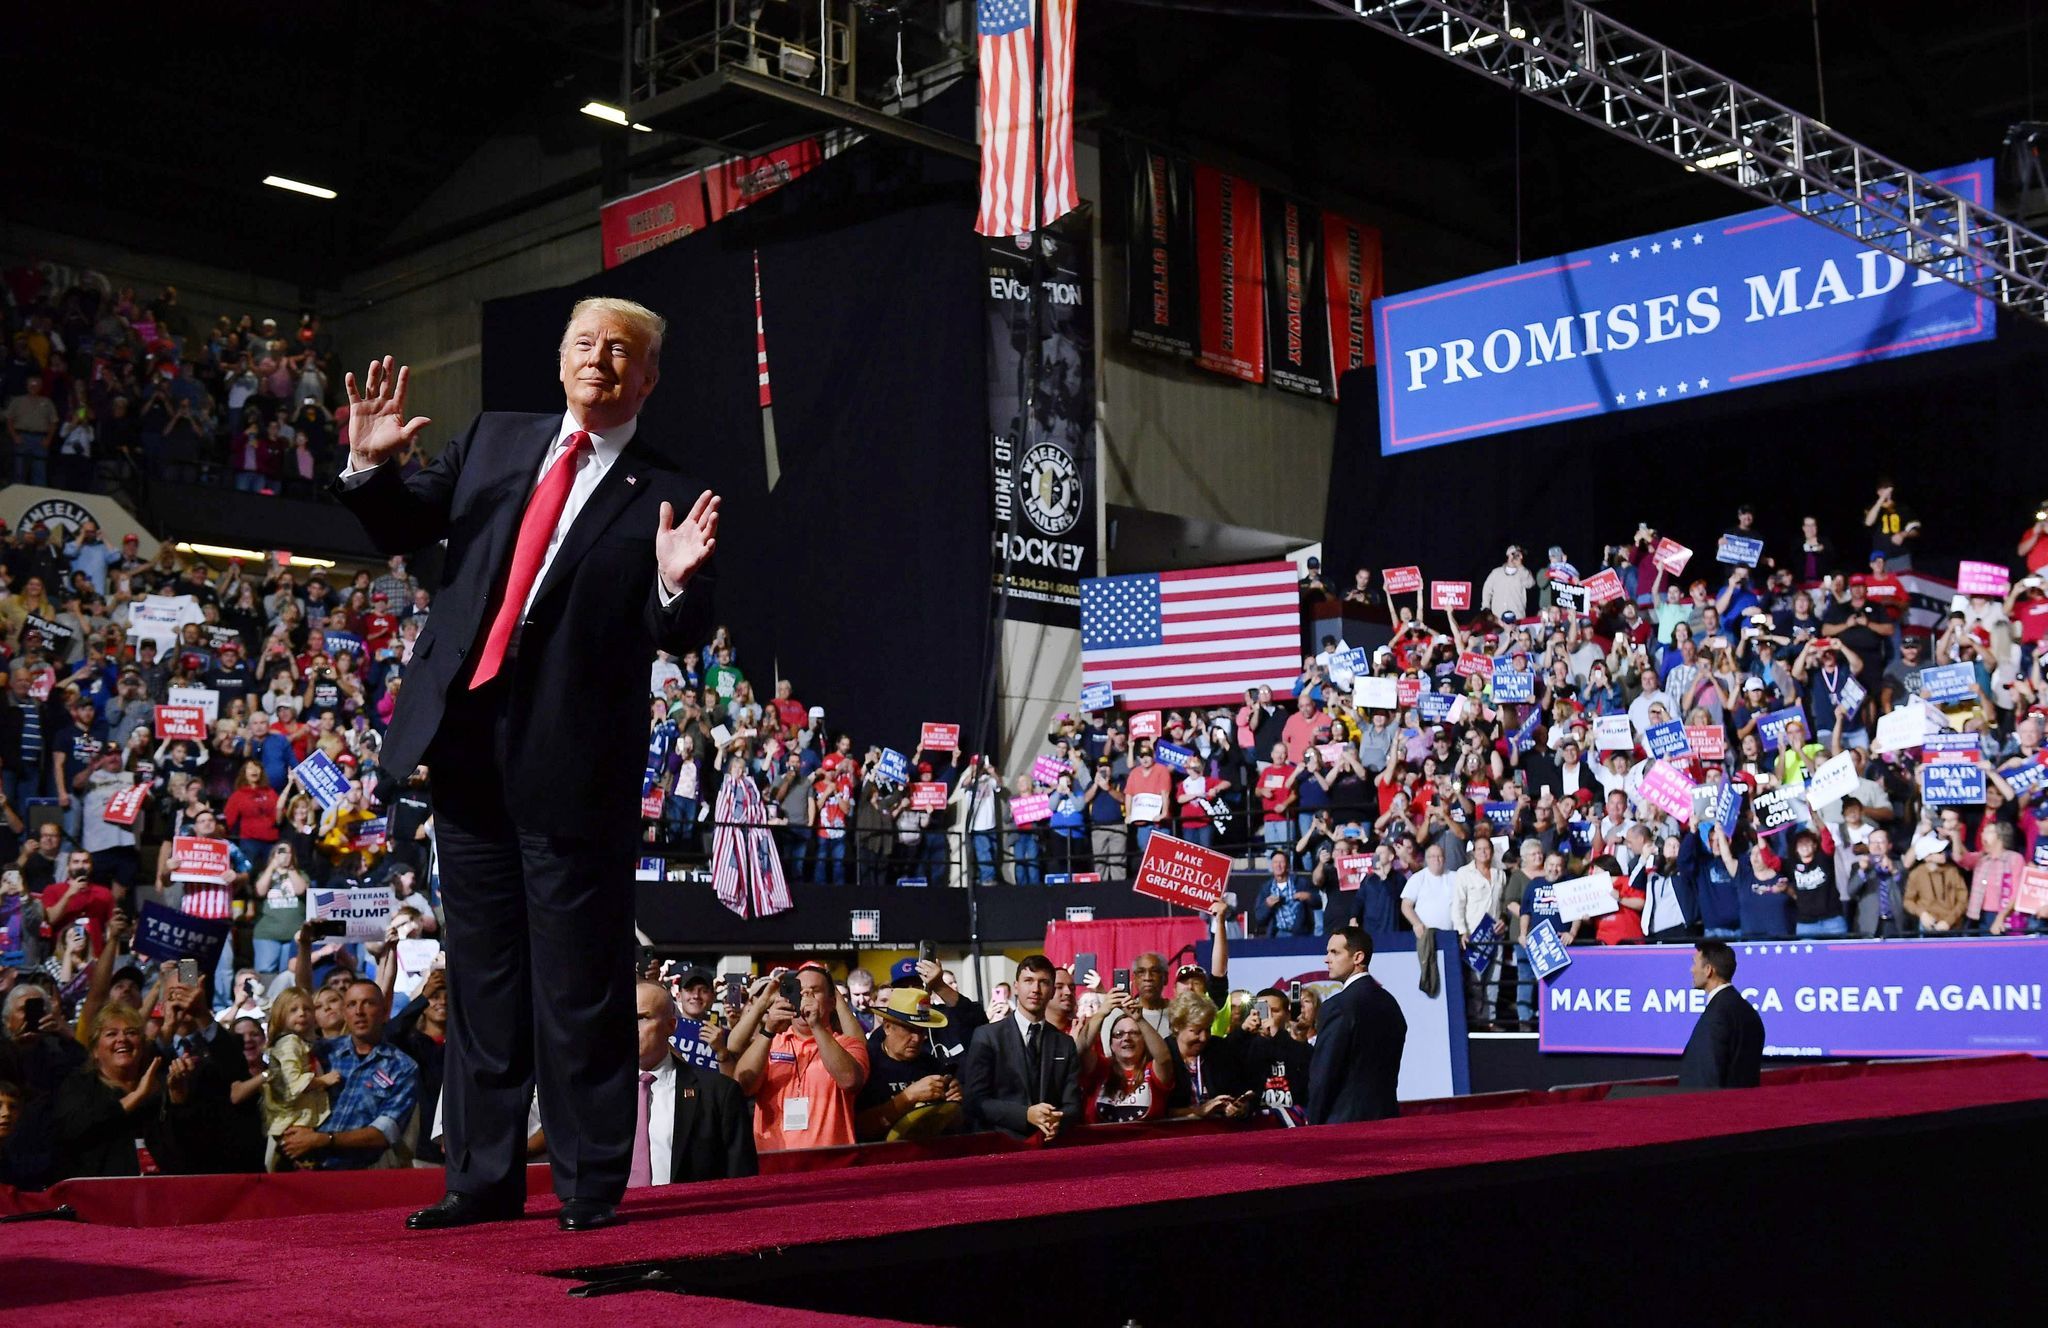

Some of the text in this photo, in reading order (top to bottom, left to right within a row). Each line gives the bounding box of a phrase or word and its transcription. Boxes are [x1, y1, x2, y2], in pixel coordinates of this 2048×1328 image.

[1405, 287, 1721, 391] PROMISES
[1022, 447, 1079, 491] WHEELING
[995, 436, 1013, 521] HOME OF
[20, 502, 90, 533] WHEELI
[1024, 497, 1075, 533] NAILERS
[996, 533, 1085, 572] HOCKEY
[1961, 561, 2009, 577] WOMEN
[1387, 574, 1420, 584] AMERICA
[1436, 585, 1466, 593] FINISH
[1551, 580, 1585, 596] TRUMP
[1960, 581, 2008, 594] TRUMP
[1438, 597, 1464, 606] WALL
[1556, 598, 1577, 610] COAL
[27, 614, 73, 637] TRUMP
[326, 637, 361, 649] TRUMP
[1332, 652, 1361, 664] DRAIN
[1497, 676, 1528, 685] DRAIN
[1495, 690, 1531, 699] SWAMP
[161, 709, 199, 719] FINISH
[164, 724, 198, 734] WALL
[924, 732, 957, 740] AMERICA
[1132, 725, 1156, 736] WALL
[1601, 727, 1629, 735] TRUMP
[1649, 731, 1685, 749] AMERICA
[304, 760, 339, 794] AMERIC
[1928, 767, 1977, 780] DRAIN
[1662, 781, 1681, 799] FOR
[1944, 778, 1962, 787] THE
[913, 791, 946, 799] AMERICA
[1754, 783, 1805, 810] TRUMP
[1926, 786, 1981, 799] SWAMP
[1010, 793, 1049, 808] WOMEN
[1643, 783, 1689, 818] TRUMP
[1767, 799, 1789, 815] DIGS
[1017, 809, 1053, 822] TRUMP
[1766, 810, 1797, 827] COAL
[177, 850, 228, 863] AMERICA
[1174, 851, 1204, 867] MAKE
[1343, 857, 1373, 869] FINIS
[1144, 856, 1222, 892] AMERICA
[1145, 873, 1216, 903] GREAT AGAIN
[347, 892, 390, 901] VETERANS
[373, 899, 389, 907] FOR
[330, 908, 390, 918] TRUMP
[147, 917, 218, 945] TRUMP
[149, 930, 208, 953] PENCE
[1539, 926, 1565, 962] DRAIN
[1526, 935, 1549, 973] SWAMP
[1551, 984, 2043, 1013] MAKE AMECA GREAT AGAIN!
